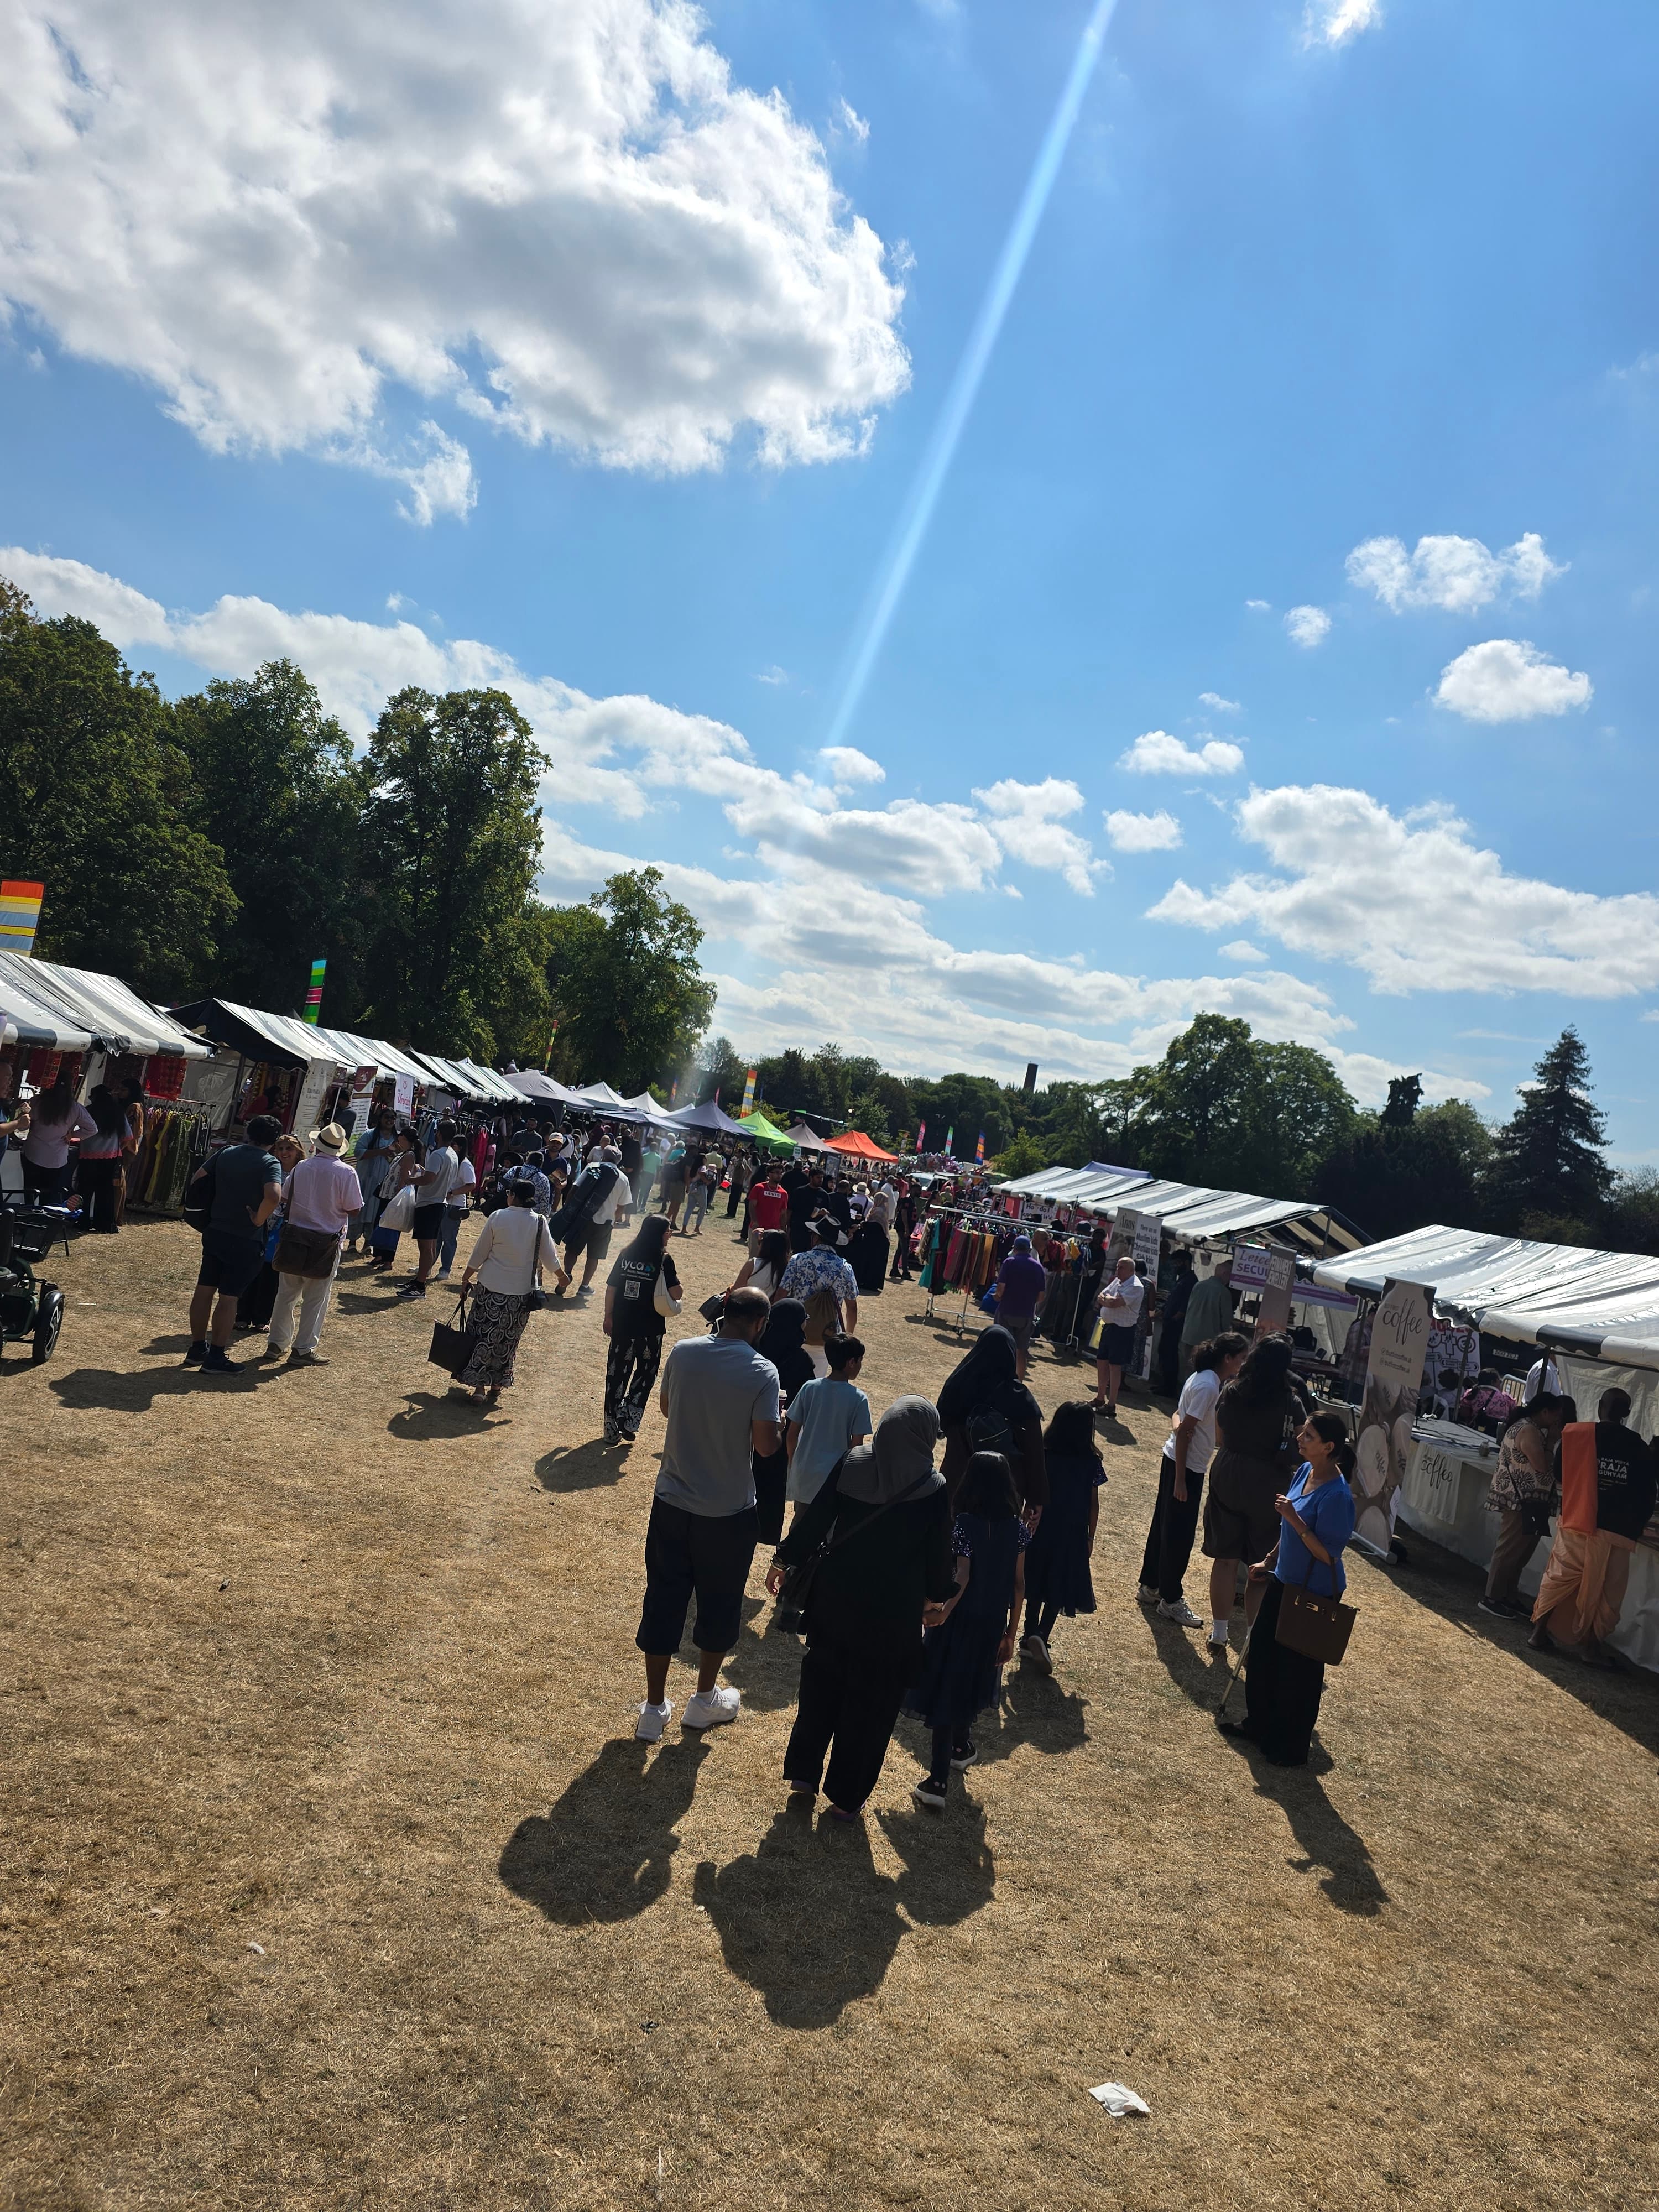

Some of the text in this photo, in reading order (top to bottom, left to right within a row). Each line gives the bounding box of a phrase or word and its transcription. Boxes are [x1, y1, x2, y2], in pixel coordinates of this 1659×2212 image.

[1239, 1250, 1270, 1265] Leice
[1383, 1298, 1422, 1345] coffee
[1421, 1454, 1453, 1490] coffee
[1598, 1469, 1627, 1479] GUHYAM
[1600, 1461, 1627, 1474] RAJA
